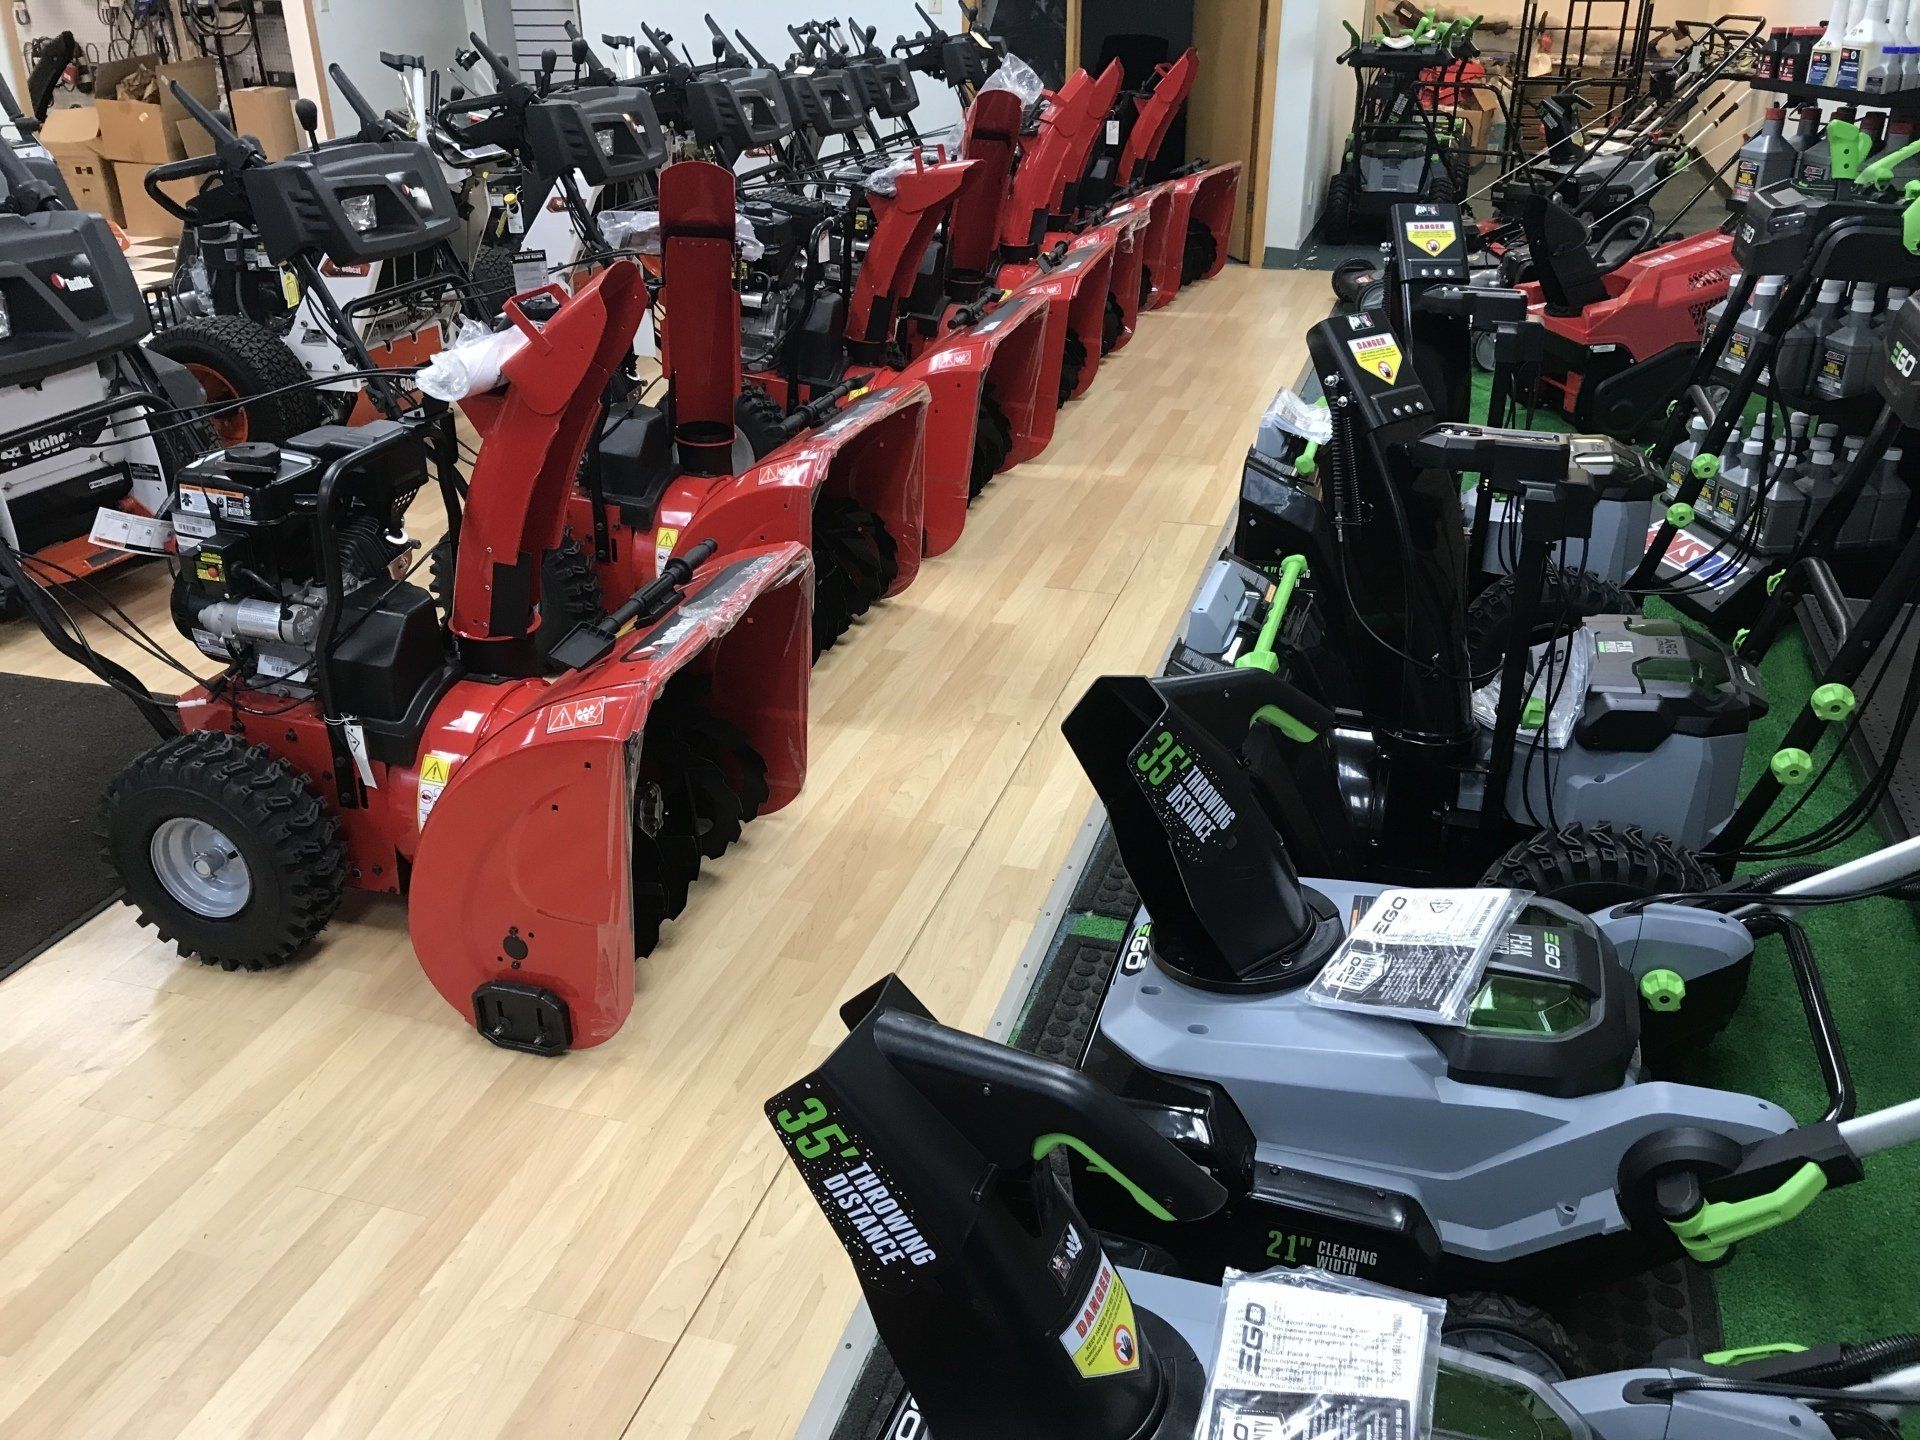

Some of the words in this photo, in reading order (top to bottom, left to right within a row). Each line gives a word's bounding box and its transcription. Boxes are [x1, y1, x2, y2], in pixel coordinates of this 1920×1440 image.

[1355, 337, 1387, 350] DANGER
[1890, 340, 1917, 378] EGO
[1137, 731, 1193, 785] 35'
[1165, 783, 1217, 843] DISTANCE
[1182, 764, 1236, 831] THROWING
[1372, 896, 1408, 935] EGO
[1125, 924, 1151, 970] EGO
[1509, 933, 1533, 958] PEAK
[1543, 931, 1561, 969] EGO
[777, 1097, 860, 1159] 35'
[822, 1172, 906, 1266] DISTANCE
[847, 1161, 937, 1266] THROWING
[1266, 1230, 1312, 1262] 21"
[1316, 1254, 1357, 1276] WIDTH
[1317, 1240, 1378, 1266] CLEARING
[1076, 1268, 1111, 1338] DANGER
[1238, 1302, 1267, 1376] EGO
